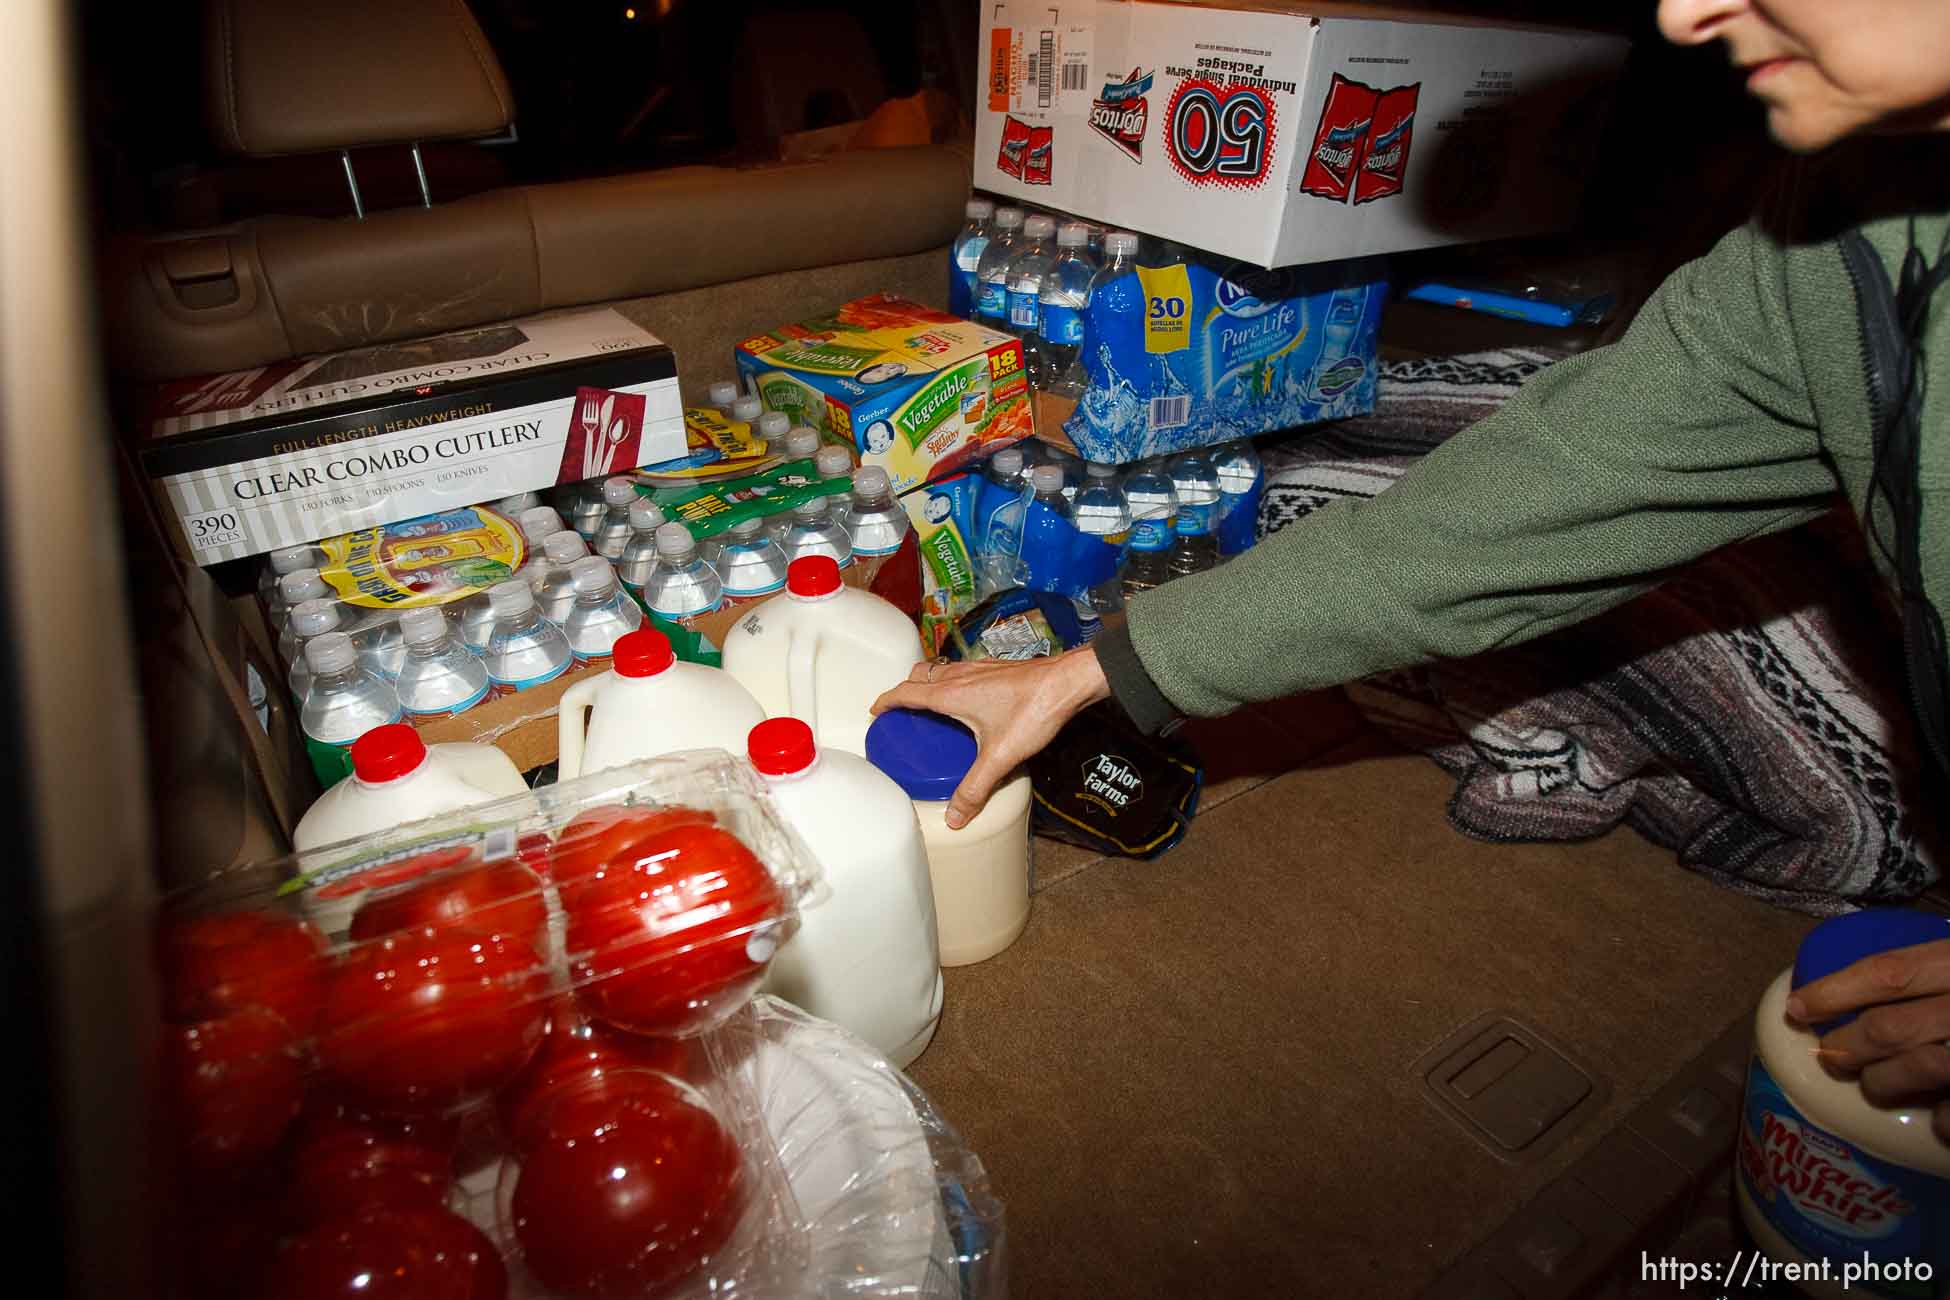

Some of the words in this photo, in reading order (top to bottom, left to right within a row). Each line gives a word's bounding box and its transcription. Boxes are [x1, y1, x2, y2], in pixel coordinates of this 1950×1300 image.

[1166, 66, 1192, 80] Serve
[1195, 69, 1225, 84] Single
[1197, 58, 1264, 76] Packages
[1228, 74, 1296, 95] Individual
[1092, 109, 1145, 134] Doritos
[1173, 87, 1266, 176] 50
[1150, 296, 1185, 319] 30
[1221, 325, 1260, 352] Pure
[1264, 305, 1295, 333] Life
[479, 351, 550, 370] CLEAR
[785, 350, 863, 369] Vegetable
[991, 350, 1017, 370] 18
[993, 363, 1019, 379] PACK
[374, 365, 472, 388] COMBO
[828, 402, 851, 429] 18
[858, 407, 888, 423] Gerber
[902, 375, 968, 433] Vegetable
[273, 424, 379, 456] FULL-LENGTH
[385, 402, 494, 433] HEAVYWEIGHT
[233, 467, 324, 500] CLEAR
[326, 445, 429, 482] COMBO
[435, 419, 543, 458] CUTLERY
[301, 503, 319, 512] 130
[319, 494, 354, 509] FORKS
[382, 479, 425, 494] SPOONS
[436, 473, 452, 483] 130
[453, 465, 489, 480] KNIVES
[191, 512, 237, 537] 390
[198, 530, 241, 547] PIECES
[933, 530, 968, 594] Vegetable
[1096, 754, 1141, 789] Taylor
[1084, 772, 1129, 805] Farms
[1762, 1110, 1913, 1214] Miracle
[1768, 1149, 1885, 1227] Whip
